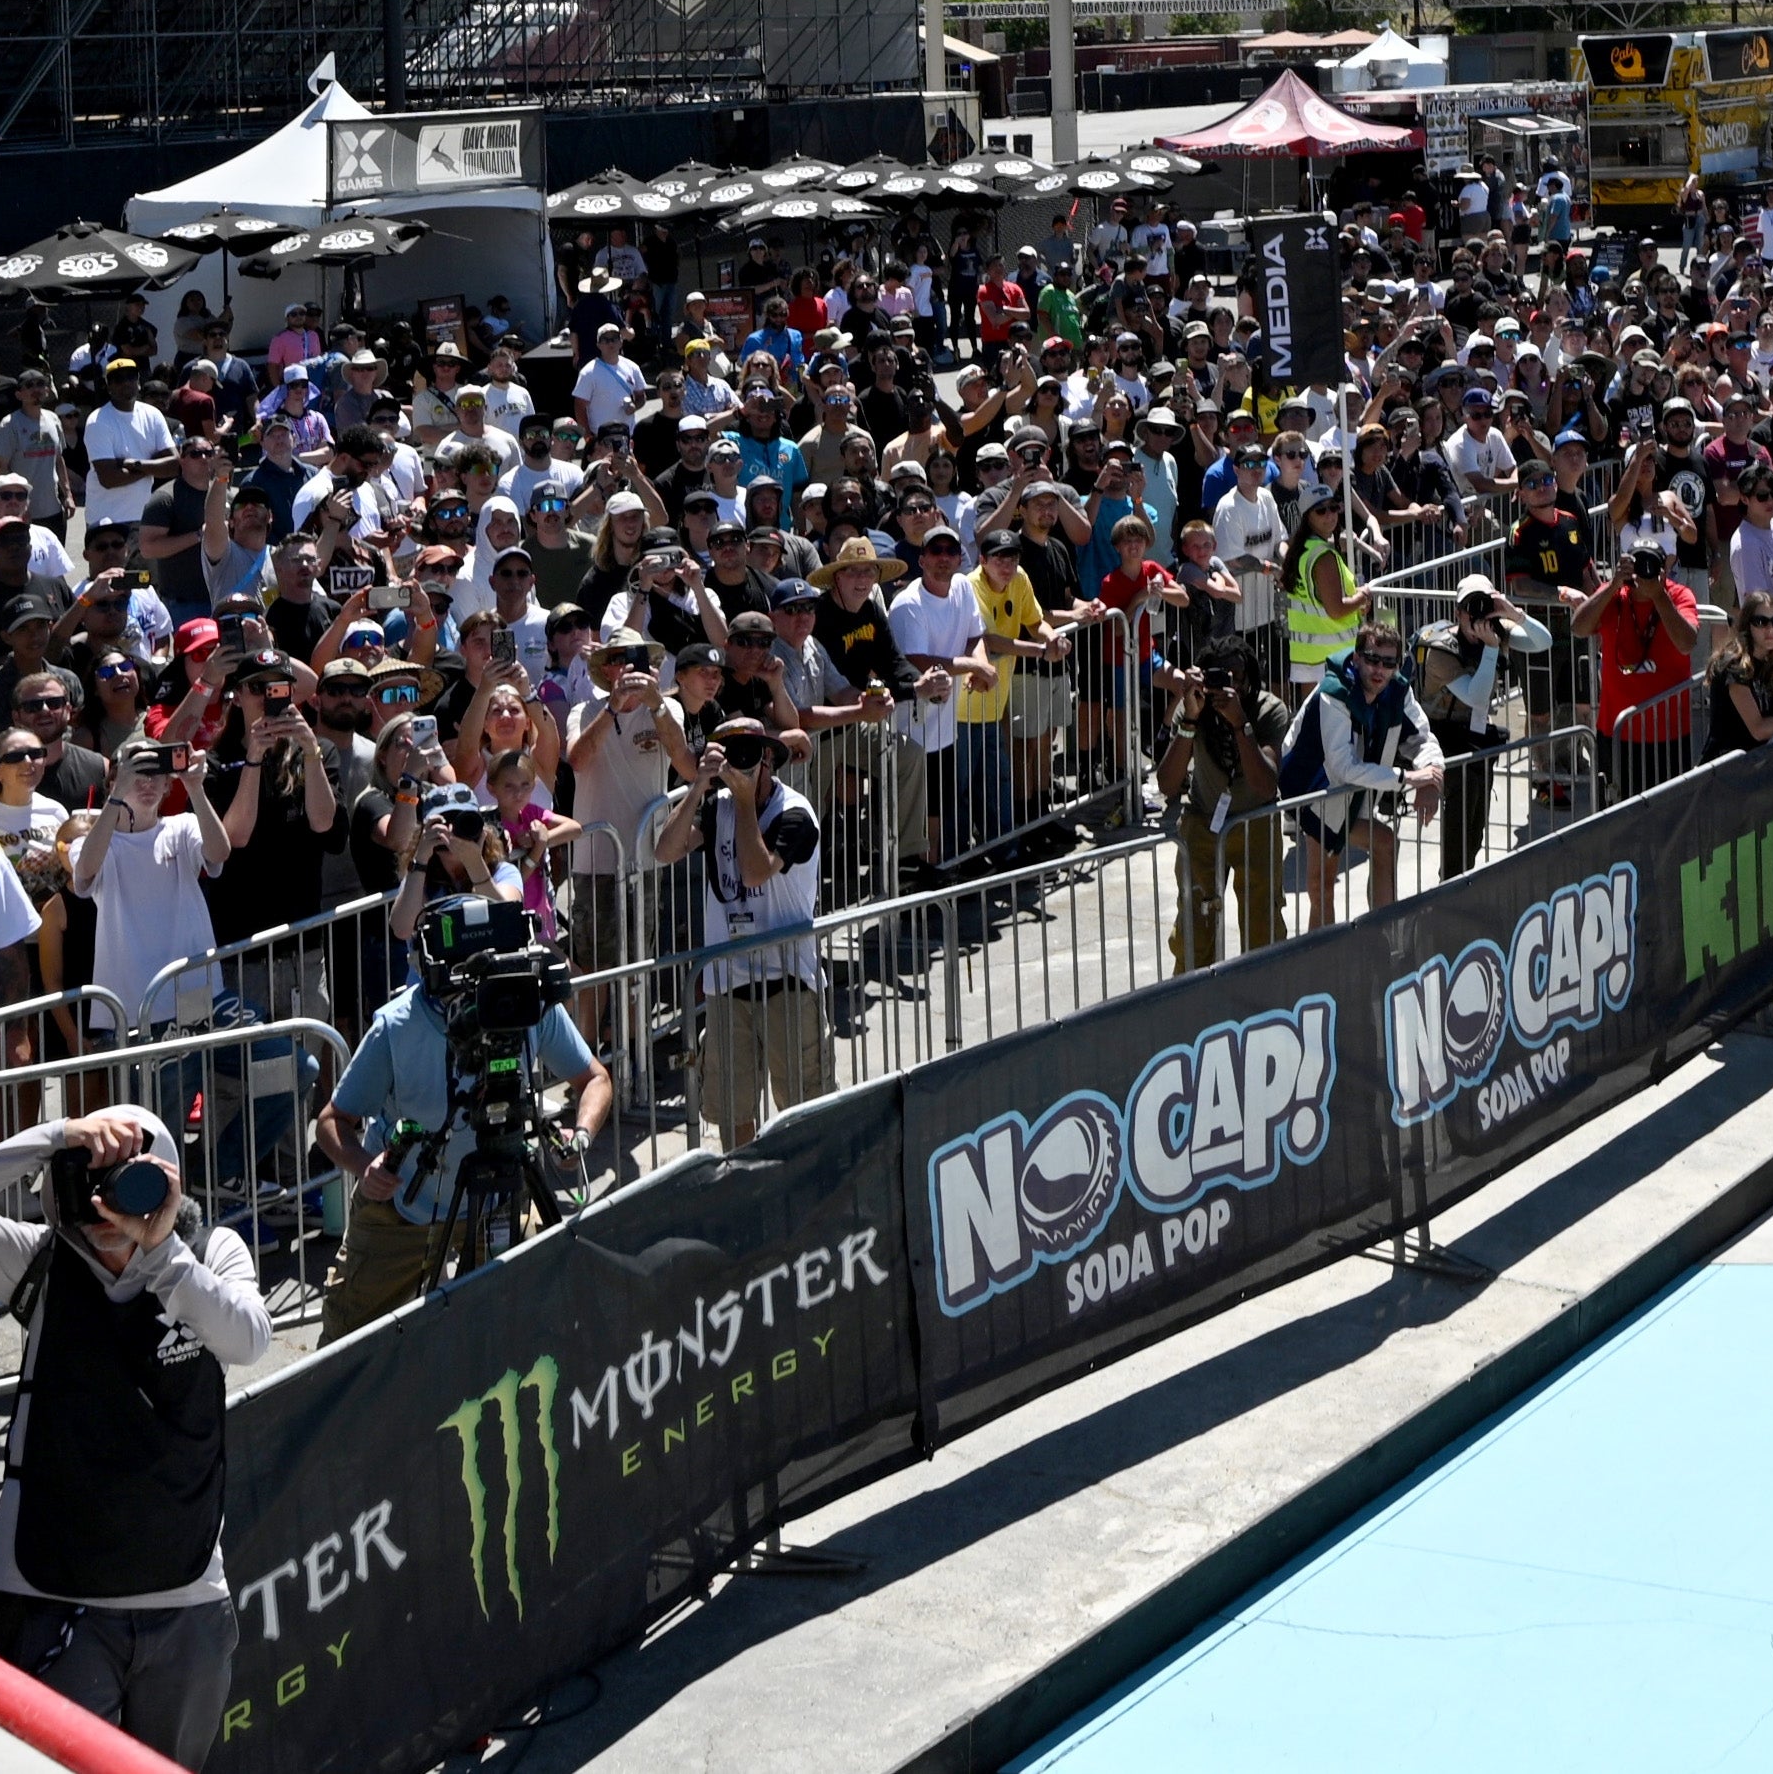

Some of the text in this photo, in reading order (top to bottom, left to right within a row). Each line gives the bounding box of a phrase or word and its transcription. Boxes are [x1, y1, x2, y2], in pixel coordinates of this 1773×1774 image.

[462, 123, 518, 150] DAVE MIRRA
[1704, 122, 1749, 148] SMOKED
[463, 149, 516, 176] FOUNDATION
[336, 175, 384, 193] GAMES
[318, 230, 376, 251] 805
[57, 254, 119, 278] 805
[1263, 233, 1293, 377] MEDIA
[1538, 549, 1560, 574] 10
[461, 929, 494, 940] SONY
[1388, 864, 1634, 1121] NO CAP!
[1476, 1036, 1571, 1131] SODA POP
[932, 998, 1333, 1310] NO CAP!
[1065, 1198, 1231, 1315] SODA POP
[157, 1339, 204, 1360] GAMES
[162, 1349, 201, 1367] PHOTO
[621, 1328, 836, 1478] ENERGY
